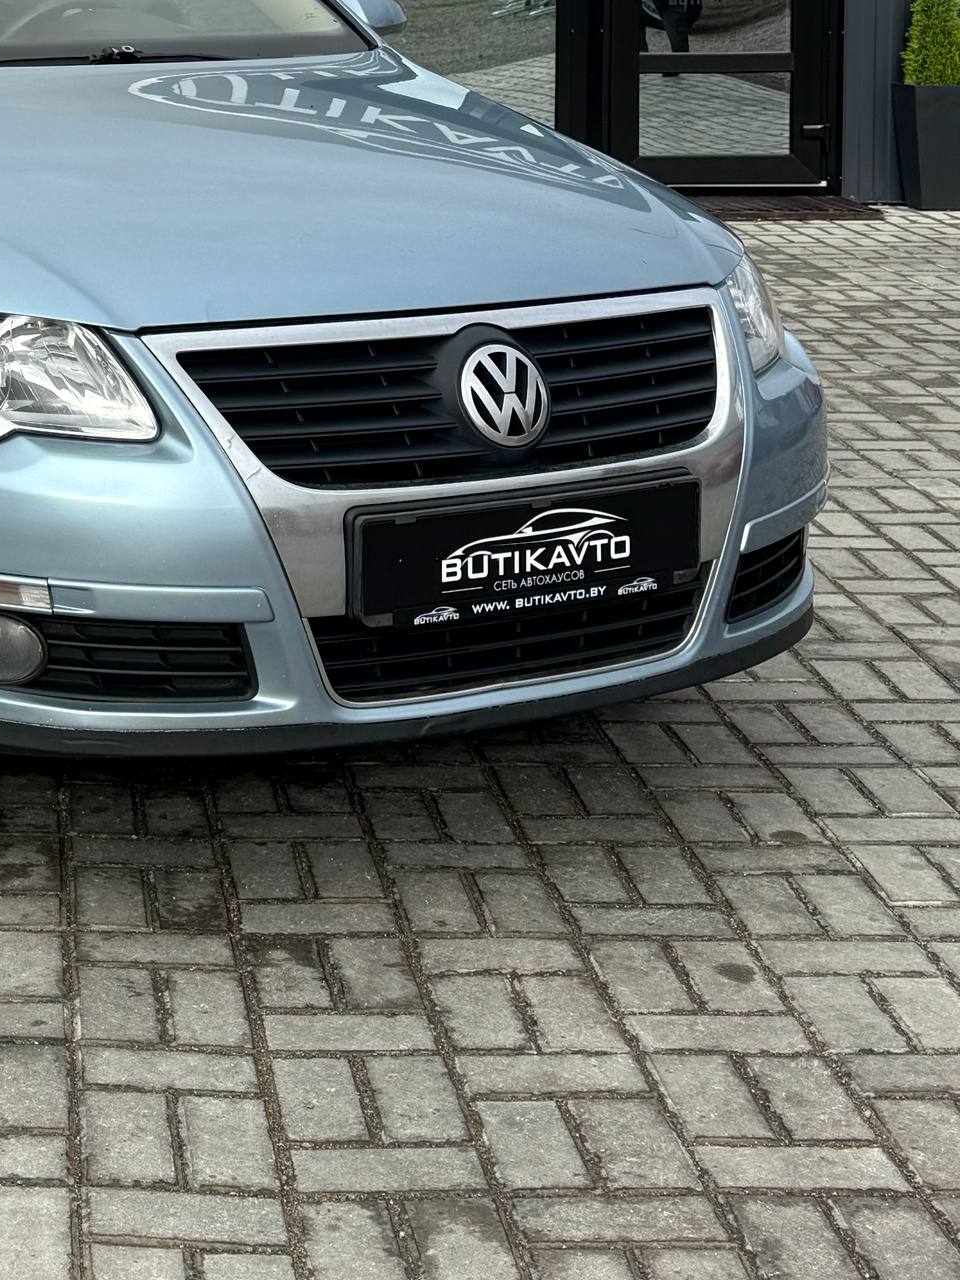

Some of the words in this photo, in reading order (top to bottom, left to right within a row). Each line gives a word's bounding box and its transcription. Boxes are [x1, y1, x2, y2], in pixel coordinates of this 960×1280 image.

[442, 535, 631, 583] BUTIKAVTO
[493, 579, 518, 592] СЕТЬ
[519, 569, 585, 589] АВТОХАУСОВ
[617, 583, 658, 596] BUTIKAVTO
[515, 585, 607, 609] BUTIKAVTO.BY
